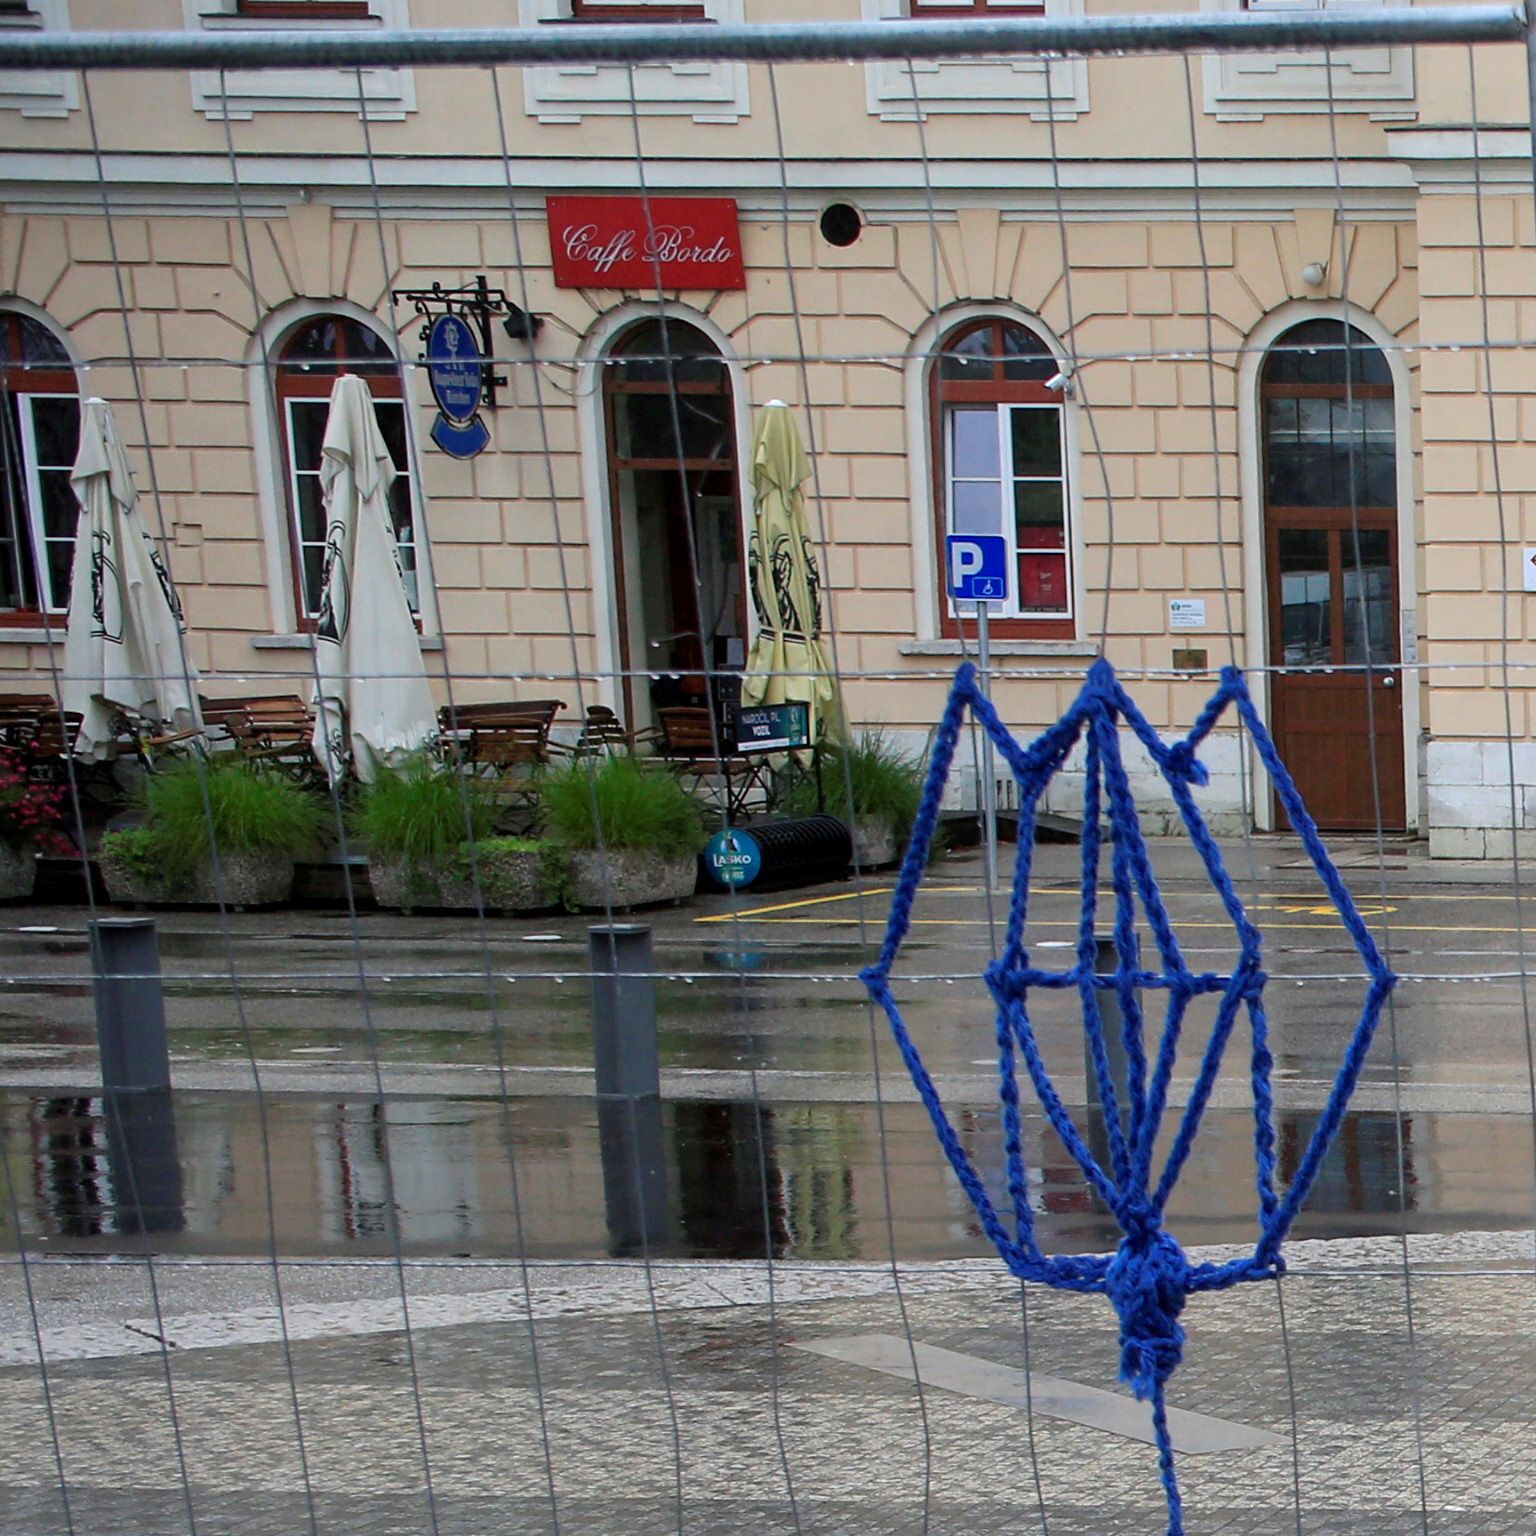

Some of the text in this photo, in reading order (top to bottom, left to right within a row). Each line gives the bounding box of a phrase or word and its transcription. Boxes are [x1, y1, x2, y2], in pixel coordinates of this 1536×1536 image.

[563, 224, 734, 272] Caffe Bordo
[951, 542, 983, 588] P
